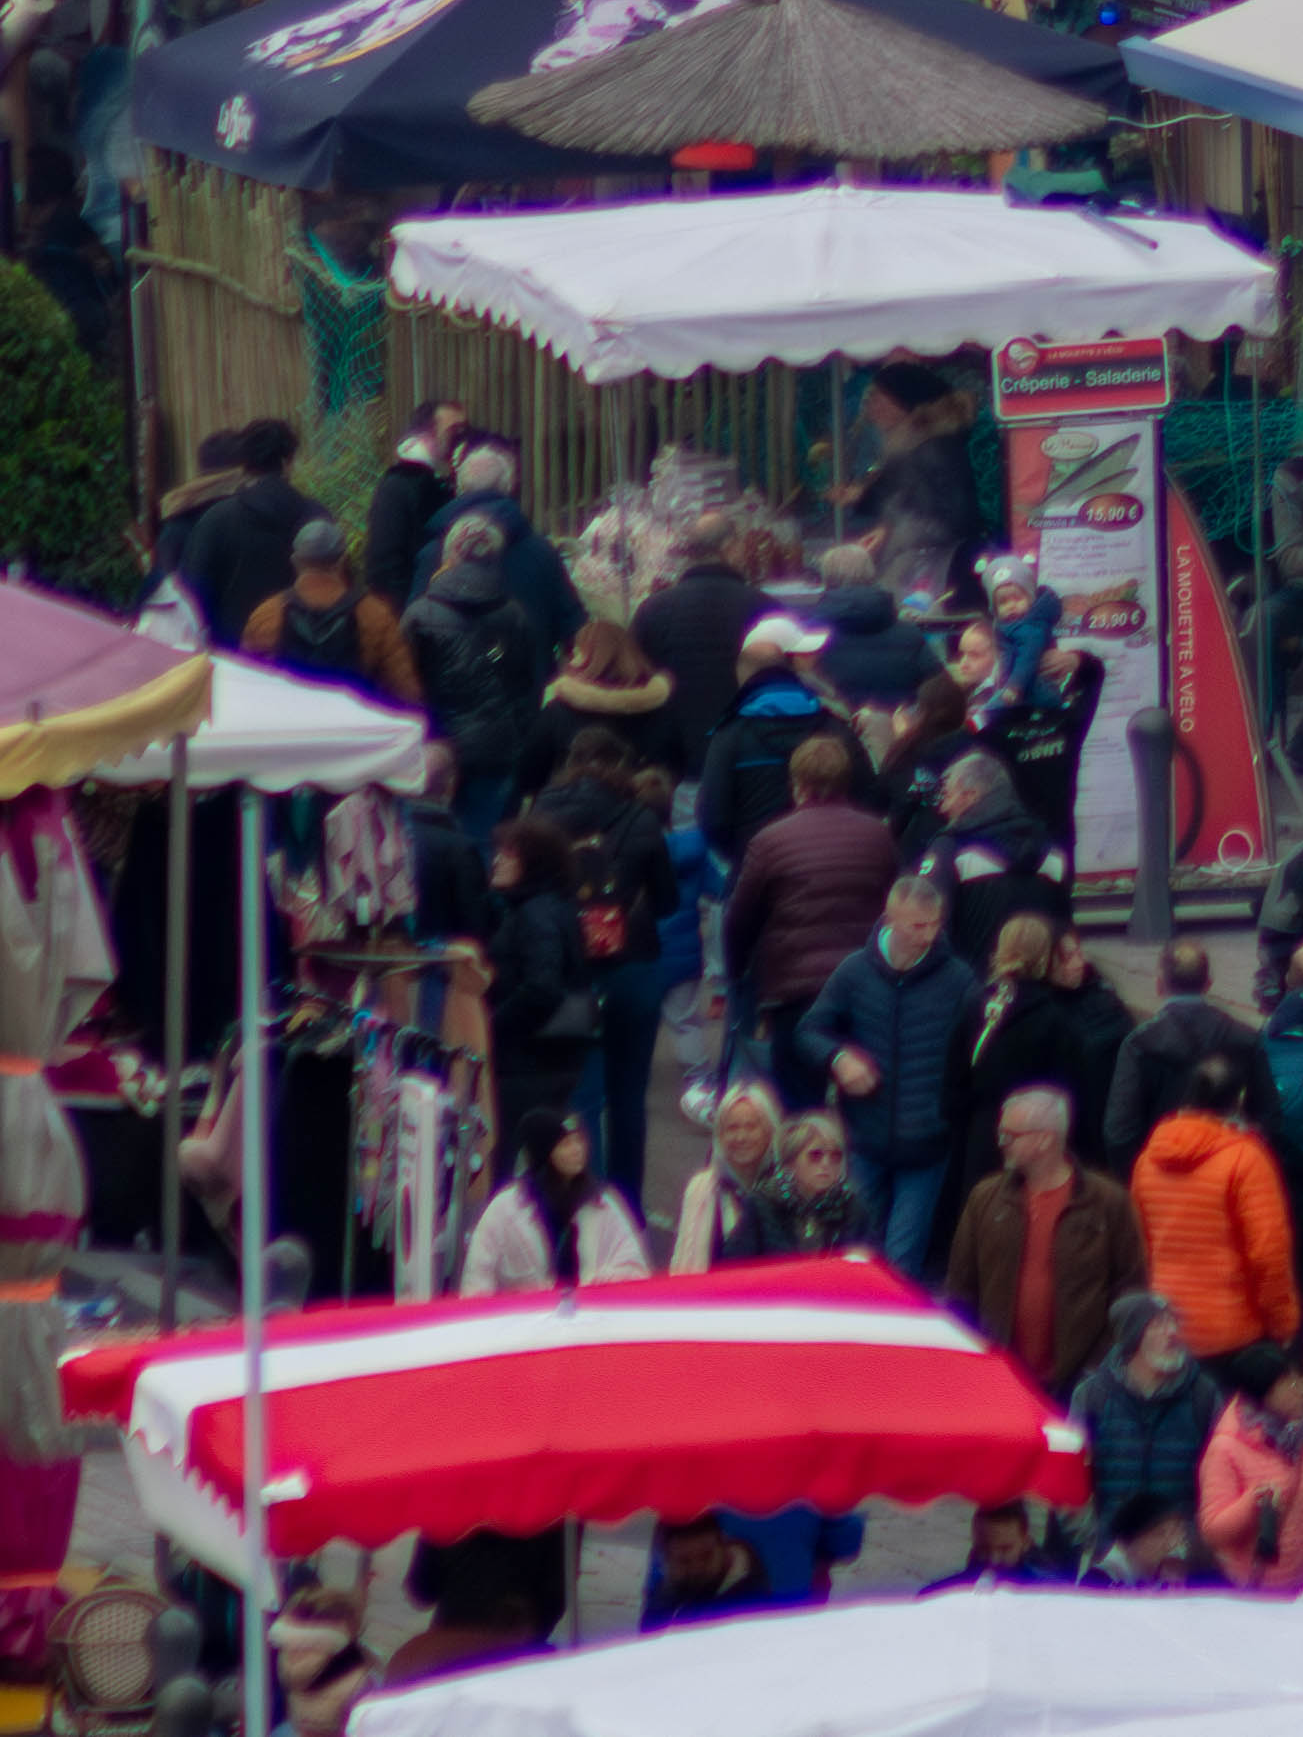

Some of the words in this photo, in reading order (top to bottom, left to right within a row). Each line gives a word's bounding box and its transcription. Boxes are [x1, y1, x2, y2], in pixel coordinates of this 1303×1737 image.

[1001, 375, 1070, 395] Crêperie
[1085, 367, 1161, 387] Saladerie
[1176, 544, 1191, 569] LA
[1177, 572, 1194, 662] MOUETTE
